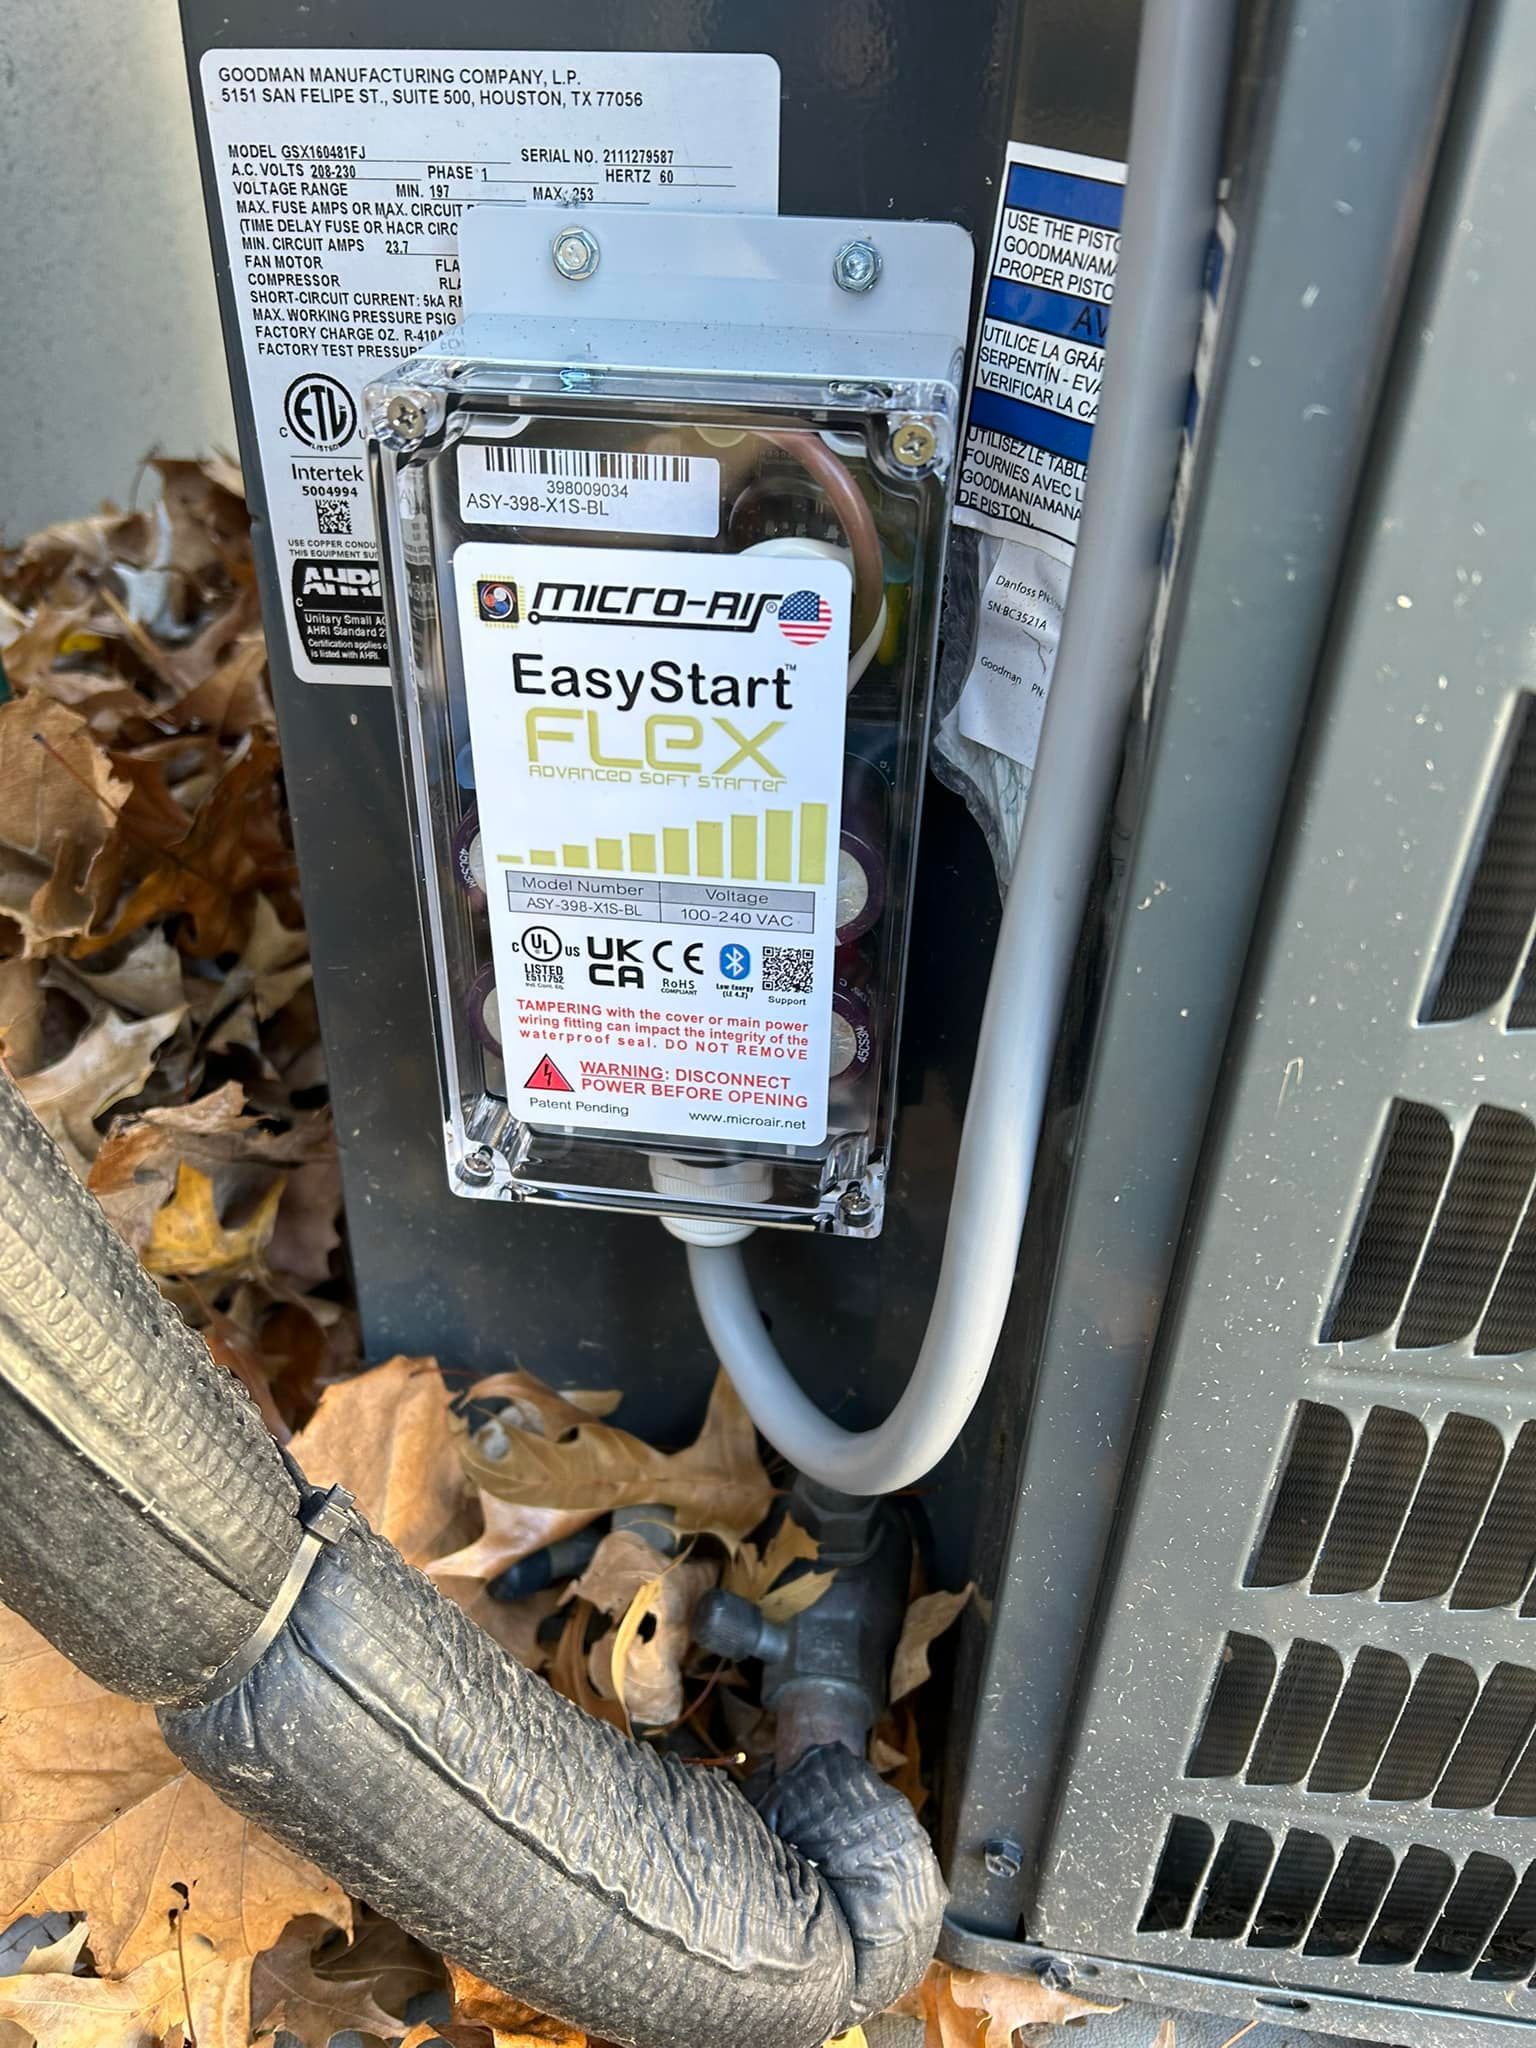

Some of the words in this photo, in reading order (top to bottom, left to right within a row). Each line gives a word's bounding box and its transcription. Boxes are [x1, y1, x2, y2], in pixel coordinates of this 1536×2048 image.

[218, 66, 305, 84] GOODMAN
[309, 67, 457, 86] MANUFACTURING
[459, 69, 550, 87] COMPANY,
[552, 70, 581, 86] L.P.
[221, 88, 259, 103] 5151
[263, 89, 297, 104] SAN
[301, 89, 356, 104] FELIPE
[358, 90, 389, 106] ST.,
[392, 90, 441, 105] SUITE
[443, 91, 475, 108] 500,
[479, 91, 568, 109] HOUSTON,
[572, 92, 594, 107] TX
[597, 92, 643, 107] 77056
[228, 144, 277, 159] MODEL
[281, 145, 367, 160] GSX160481FJ
[521, 148, 571, 163] SERIAL
[574, 149, 599, 164] NO.
[603, 149, 675, 165] 2111279587
[231, 163, 258, 177] A.C.
[260, 163, 305, 177] VOLTS
[311, 164, 357, 179] 208-230
[427, 165, 473, 180] PHASE
[481, 167, 489, 182] 1
[605, 168, 652, 183] HERTZ
[659, 169, 675, 184] 60
[233, 182, 298, 196] VOLTAGE
[301, 182, 348, 196] RANGE
[396, 184, 424, 198] MIN.
[430, 185, 450, 199] 197
[572, 187, 595, 202] 253
[236, 200, 270, 214] MAX.
[272, 200, 307, 215] FUSE
[311, 201, 348, 215] AMPS
[352, 202, 373, 216] OR
[375, 203, 408, 218] MAX.
[411, 203, 463, 218] CIRCUIT
[240, 218, 274, 235] (TIME
[277, 218, 322, 233] DELAY
[325, 219, 360, 234] FUSE
[363, 220, 384, 235] OR
[386, 220, 425, 235] HACR
[1007, 211, 1039, 234] USE
[1043, 217, 1073, 243] THE
[242, 237, 270, 251] MIN.
[272, 238, 323, 252] CIRCUIT
[327, 239, 365, 252] AMPS
[385, 240, 409, 255] 23.7
[244, 255, 271, 269] FAN
[274, 255, 324, 270] MOTOR
[435, 259, 461, 273] FLA
[999, 259, 1063, 288] PROPER
[247, 273, 341, 288] COMPRESSOR
[250, 291, 350, 306] SHORT-CIRCUIT
[353, 293, 421, 308] CURRENT:
[423, 294, 446, 308] 5kA
[252, 308, 285, 322] MAX.
[287, 308, 350, 323] WORKING
[353, 310, 423, 325] PRESSURE
[426, 312, 457, 326] PSIG
[255, 325, 317, 340] FACTORY
[319, 326, 374, 341] CHARGE
[378, 328, 399, 341] OZ.
[983, 324, 1039, 354] UTILICE
[1041, 340, 1060, 361] LA
[258, 342, 318, 357] FACTORY
[321, 343, 354, 357] TEST
[980, 347, 1060, 384] SERPENTÍN
[981, 368, 1053, 405] VERIFICAR
[1056, 393, 1073, 413] LA
[293, 384, 348, 442] ETL
[968, 427, 1028, 459] UTILISEZ
[1028, 446, 1045, 466] LE
[291, 463, 365, 482] Intertek
[964, 447, 1030, 484] FOURNIES
[1032, 473, 1072, 498] AVEC
[301, 486, 359, 498] 5004994
[546, 480, 629, 498] 398009034
[960, 489, 978, 507] DE
[466, 493, 610, 517] ASY-398-X1S-BL
[288, 539, 305, 548] USE
[307, 540, 343, 549] COPPER
[289, 549, 309, 558] THIS
[310, 549, 362, 559] EQUIPMENT
[303, 566, 383, 598] AHRI
[996, 575, 1037, 599] Danfoss
[304, 613, 342, 626] Unitary
[343, 614, 373, 626] Small
[306, 625, 331, 637] AHRI
[333, 626, 378, 638] Standard
[980, 655, 1022, 685] Goodman
[512, 652, 794, 712] EasyStart
[640, 773, 691, 788] SOFT
[522, 876, 573, 893] Model
[577, 880, 644, 897] Number
[705, 888, 769, 906] Voltage
[526, 897, 643, 918] ASY-398-X1S-BL
[681, 908, 752, 925] 100-240
[756, 911, 794, 927] VAC
[531, 933, 553, 956] UL
[565, 945, 581, 957] US
[587, 936, 644, 964] UK
[652, 939, 704, 976] CE
[524, 963, 564, 977] LISTED
[588, 963, 645, 990] CA
[660, 987, 698, 996] COMPLIANT
[662, 978, 696, 990] RoHS
[767, 995, 807, 1006] Support
[516, 999, 603, 1017] TAMPERING
[607, 1005, 637, 1019] with
[640, 1008, 662, 1020] the
[665, 1012, 704, 1024] cover
[708, 1014, 724, 1026] or
[727, 1015, 761, 1029] main
[765, 1020, 809, 1034] power
[518, 1014, 560, 1030] wiring
[563, 1017, 603, 1032] fitting
[606, 1021, 632, 1032] can
[635, 1023, 681, 1038] impact
[684, 1026, 706, 1038] the
[710, 1028, 767, 1046] integrity
[770, 1032, 786, 1044] of
[787, 1033, 809, 1046] the
[519, 1027, 611, 1047] waterproof
[618, 1034, 658, 1049] seal.
[665, 1038, 689, 1051] DO
[695, 1041, 729, 1055] NOT
[736, 1044, 809, 1061] REMOVE
[580, 1061, 670, 1081] WARNING:
[675, 1068, 792, 1091] DISCONNECT
[581, 1078, 647, 1096] POWER
[651, 1084, 723, 1102] BEFORE
[728, 1090, 809, 1109] OPENING
[529, 1097, 573, 1111] Patent
[575, 1100, 630, 1117] Pending
[688, 1110, 808, 1131] www.microair.net
